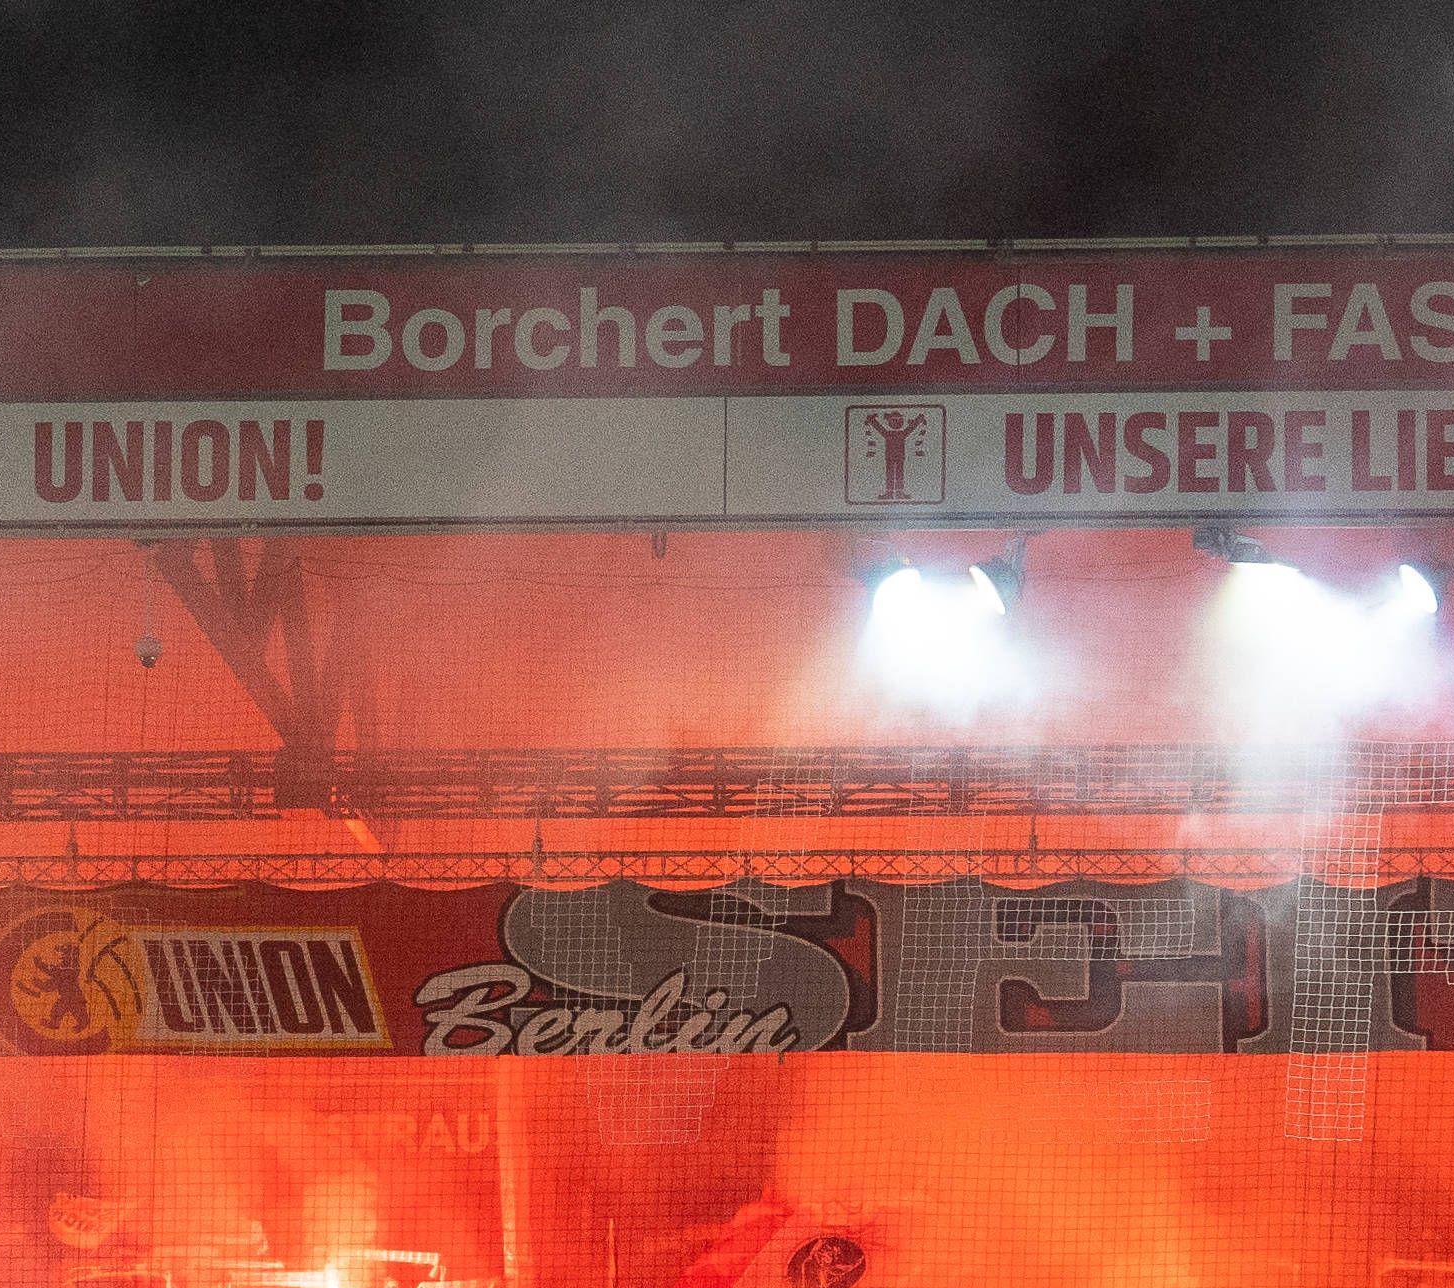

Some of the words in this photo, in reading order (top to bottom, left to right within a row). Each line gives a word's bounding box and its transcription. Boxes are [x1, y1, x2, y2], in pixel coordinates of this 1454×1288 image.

[323, 287, 791, 372] Borchert
[835, 283, 1135, 368] DACH
[34, 419, 327, 503] UNION!
[1003, 408, 1326, 494] UNSERE
[141, 936, 380, 1034] UNION
[415, 962, 802, 1056] Berlin
